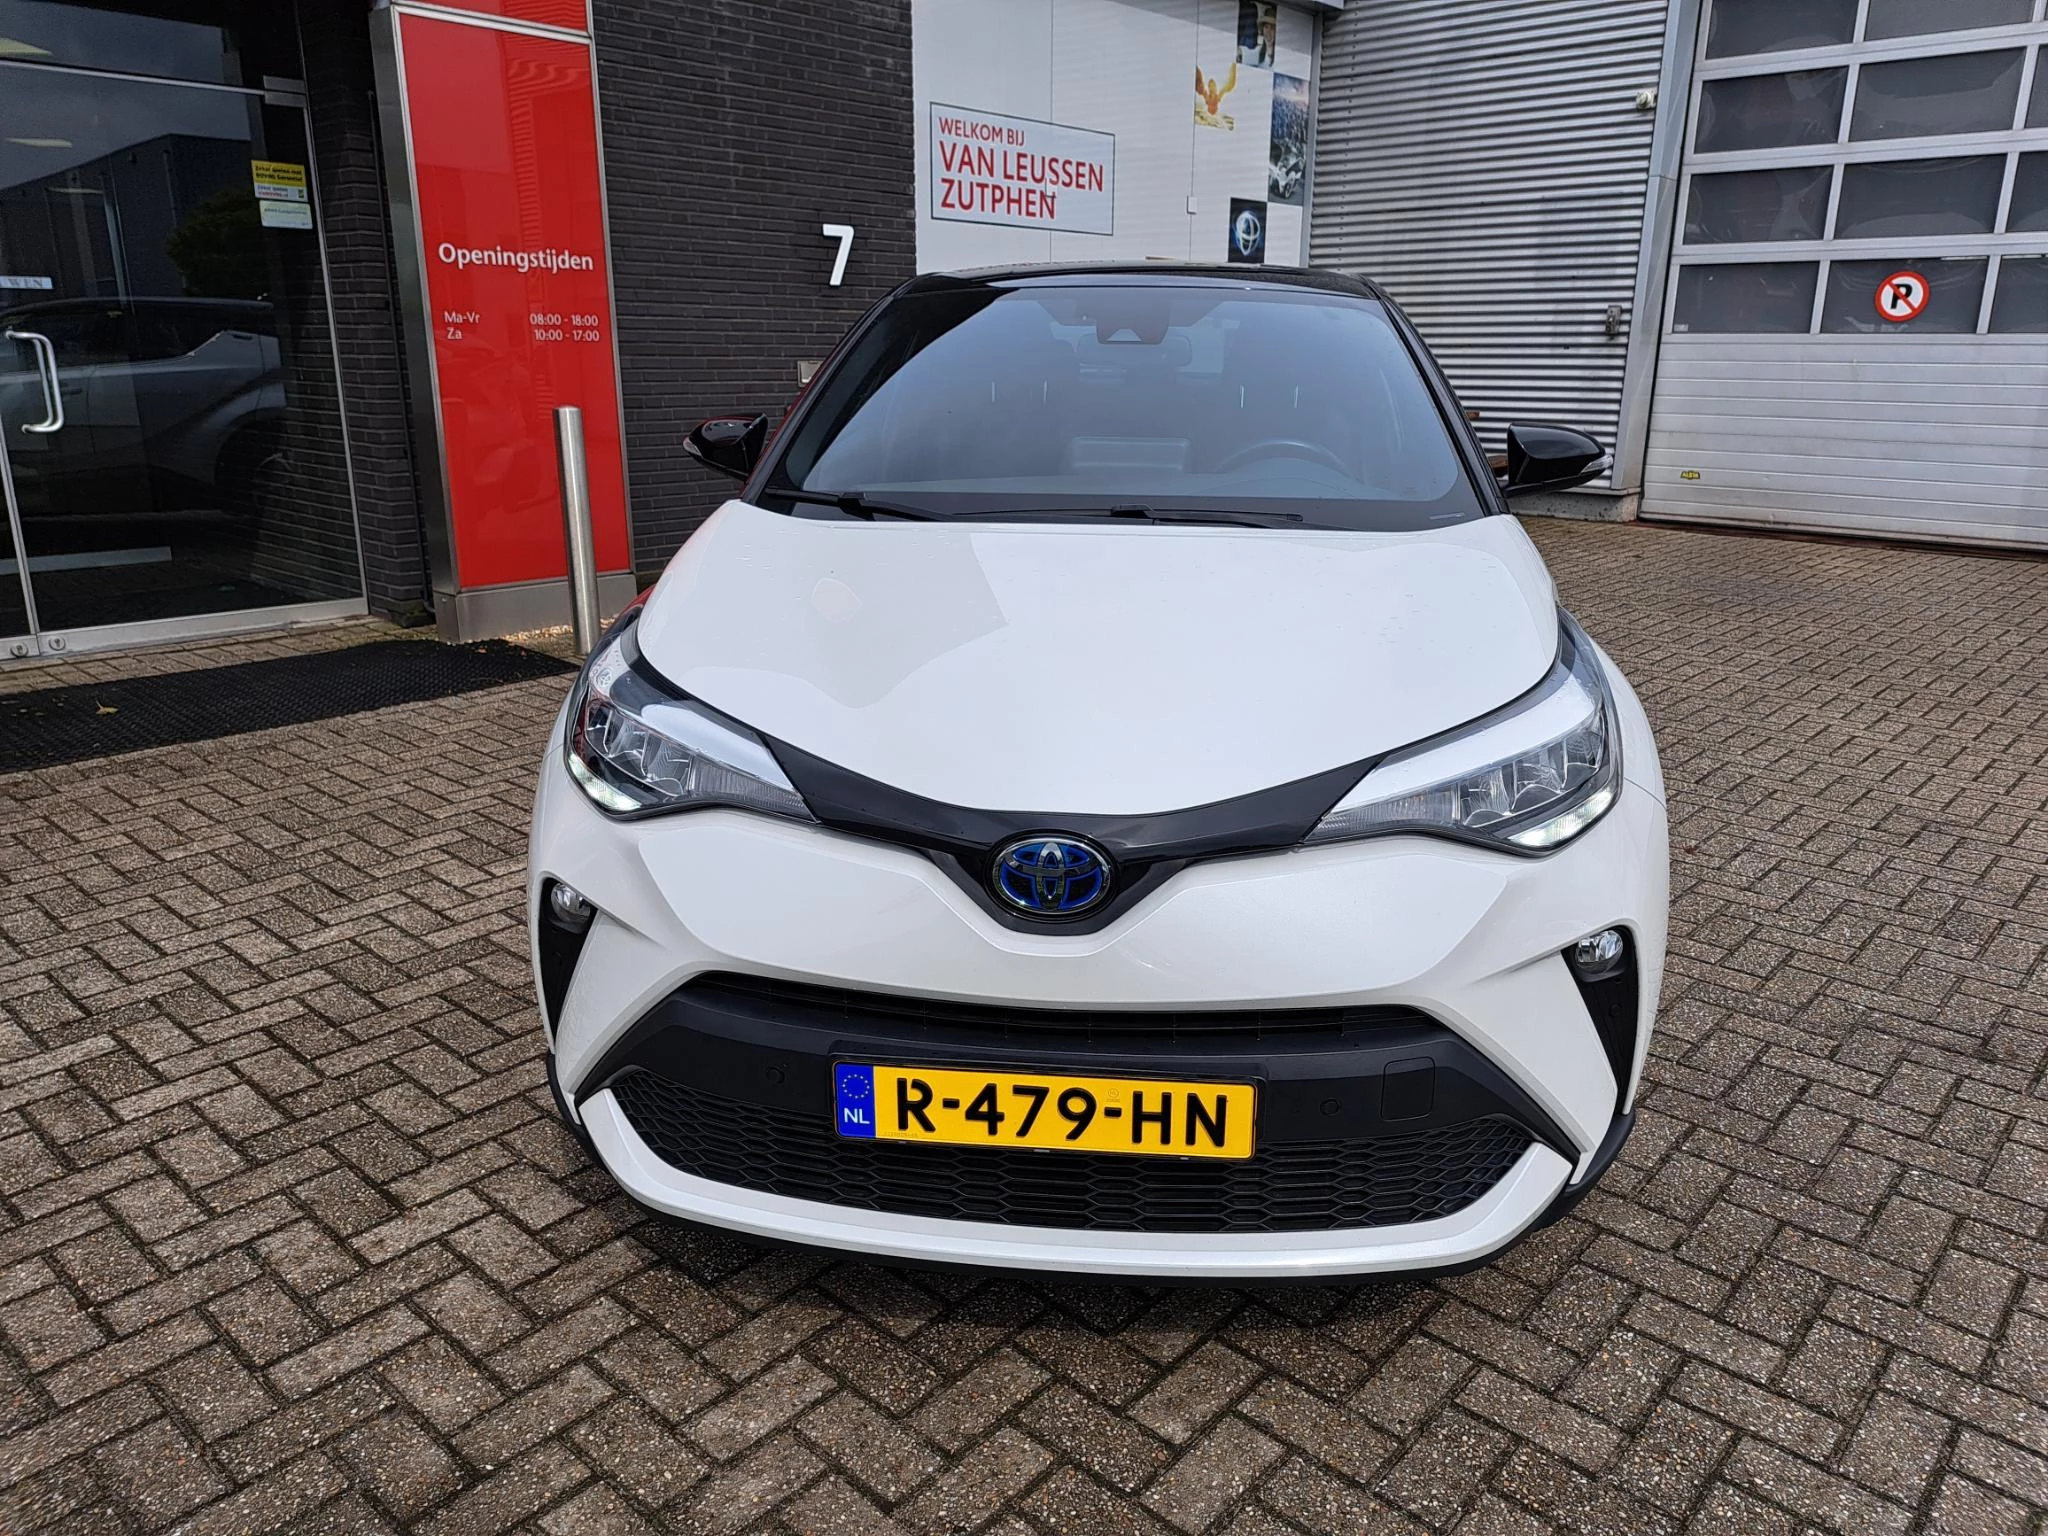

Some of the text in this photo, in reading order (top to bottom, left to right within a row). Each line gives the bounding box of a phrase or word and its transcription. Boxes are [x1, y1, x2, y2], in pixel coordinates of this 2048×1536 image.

[939, 116, 1025, 147] WELKOM BIJ
[939, 140, 1105, 193] VAN LEUSSEN
[940, 176, 1057, 220] ZUTPHEN
[437, 242, 594, 274] Openingstijden
[823, 223, 854, 286] 7
[444, 310, 481, 324] Ma-Vr
[529, 313, 562, 326] 08:00
[571, 314, 599, 327] 18:00
[446, 326, 463, 340] Za
[534, 328, 563, 341] 10:00
[572, 329, 600, 342] 17:00
[844, 1107, 871, 1125] NL
[896, 1077, 1228, 1148] R-479-HN
